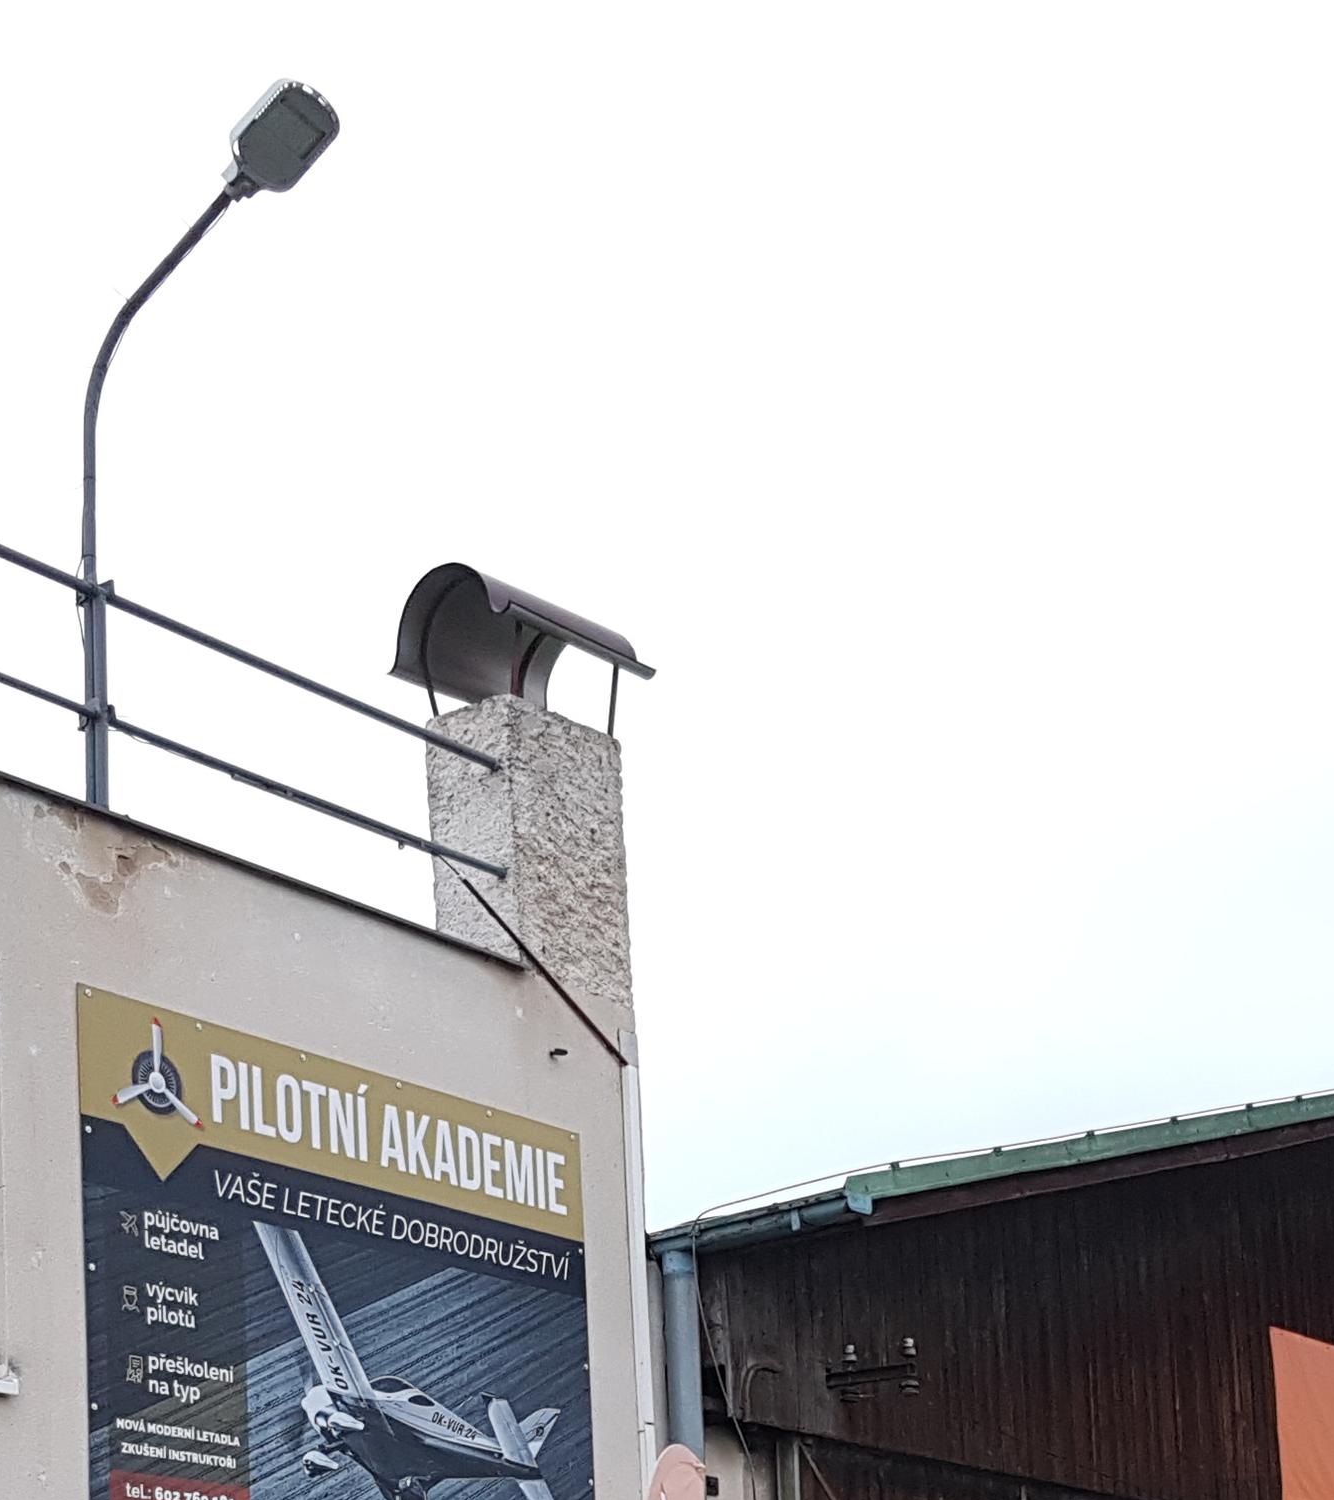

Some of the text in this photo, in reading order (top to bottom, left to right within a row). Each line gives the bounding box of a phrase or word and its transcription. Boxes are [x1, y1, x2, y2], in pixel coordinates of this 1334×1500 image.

[210, 1053, 568, 1216] PILOTNÍ AKADEMIE
[144, 1210, 219, 1241] půjčovna
[214, 1169, 570, 1281] VAŠE LETECKÉ DOBRODRUŽSTVÍ
[144, 1229, 204, 1260] letadel
[146, 1281, 199, 1307] výcvik
[148, 1378, 201, 1405] na typ
[116, 1418, 240, 1447] NOVÁ MODERNÍ LETADLA
[121, 1442, 237, 1469] ZKUŠENÍ INSTRUKTOŘI
